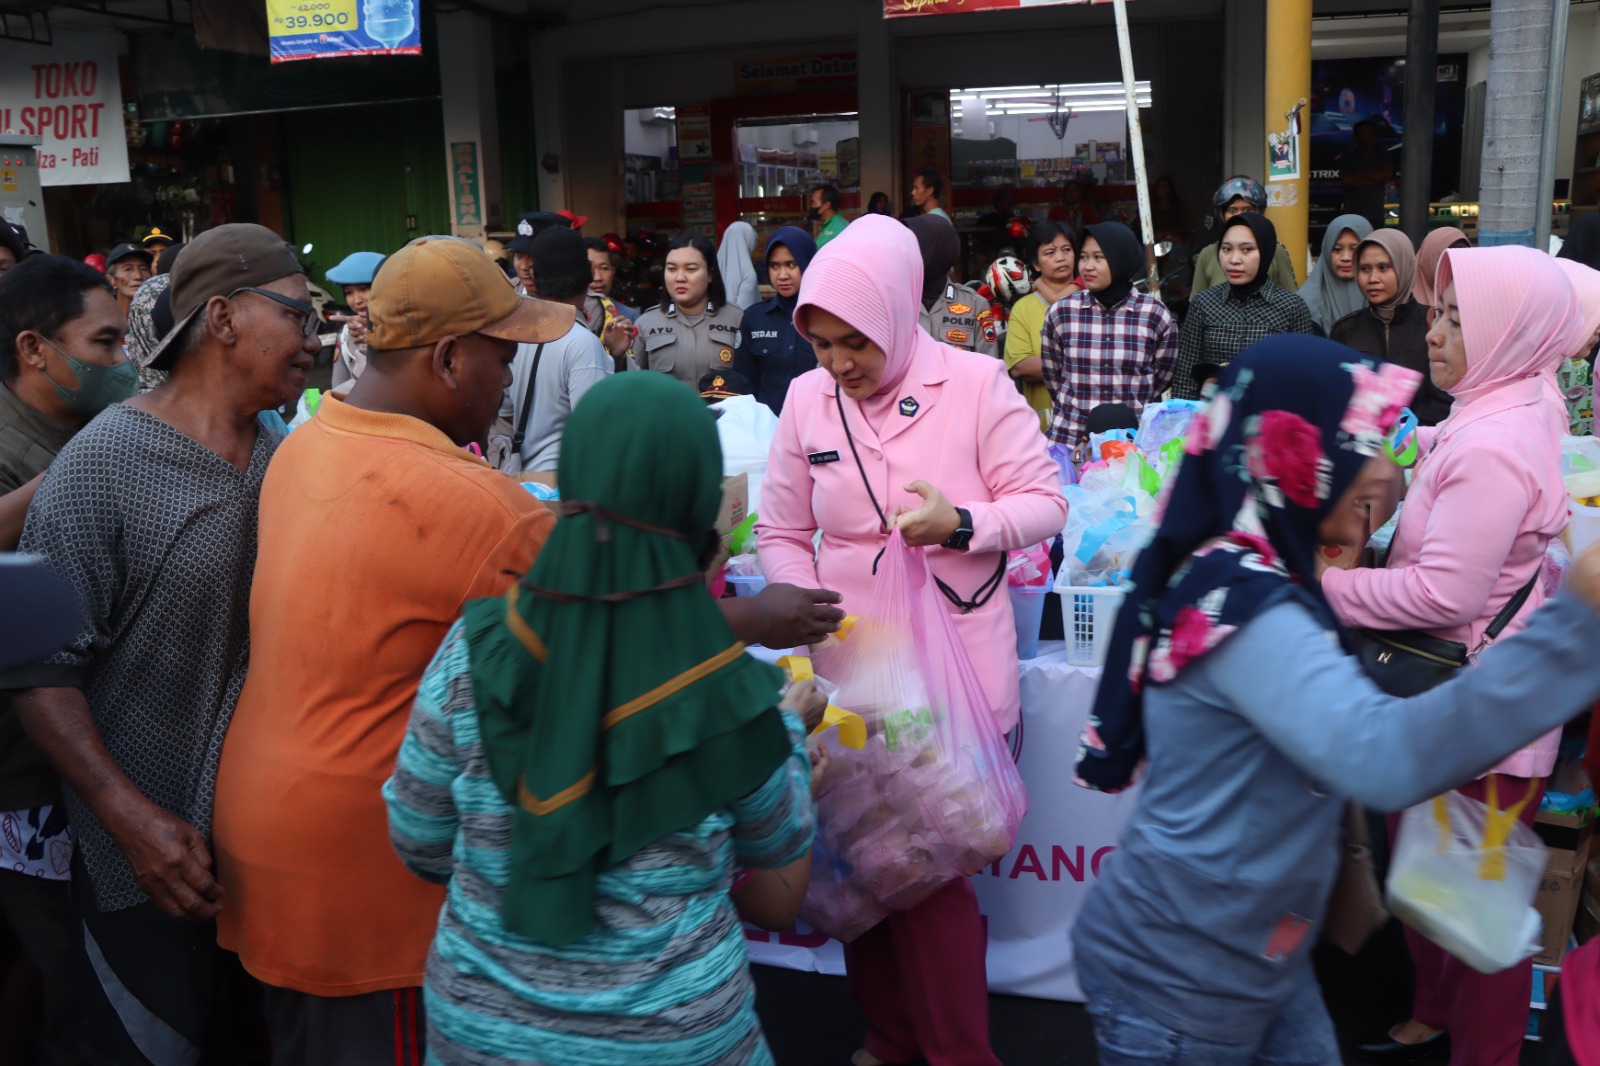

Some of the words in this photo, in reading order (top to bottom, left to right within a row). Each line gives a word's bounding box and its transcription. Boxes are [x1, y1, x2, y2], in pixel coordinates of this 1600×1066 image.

[285, 12, 349, 29] 39.900
[740, 61, 808, 79] Selamat
[31, 60, 98, 99] TOKO
[72, 147, 99, 167] Pati
[1308, 169, 1340, 178] TRIX
[942, 316, 975, 327] POLRI
[649, 327, 673, 335] AYU
